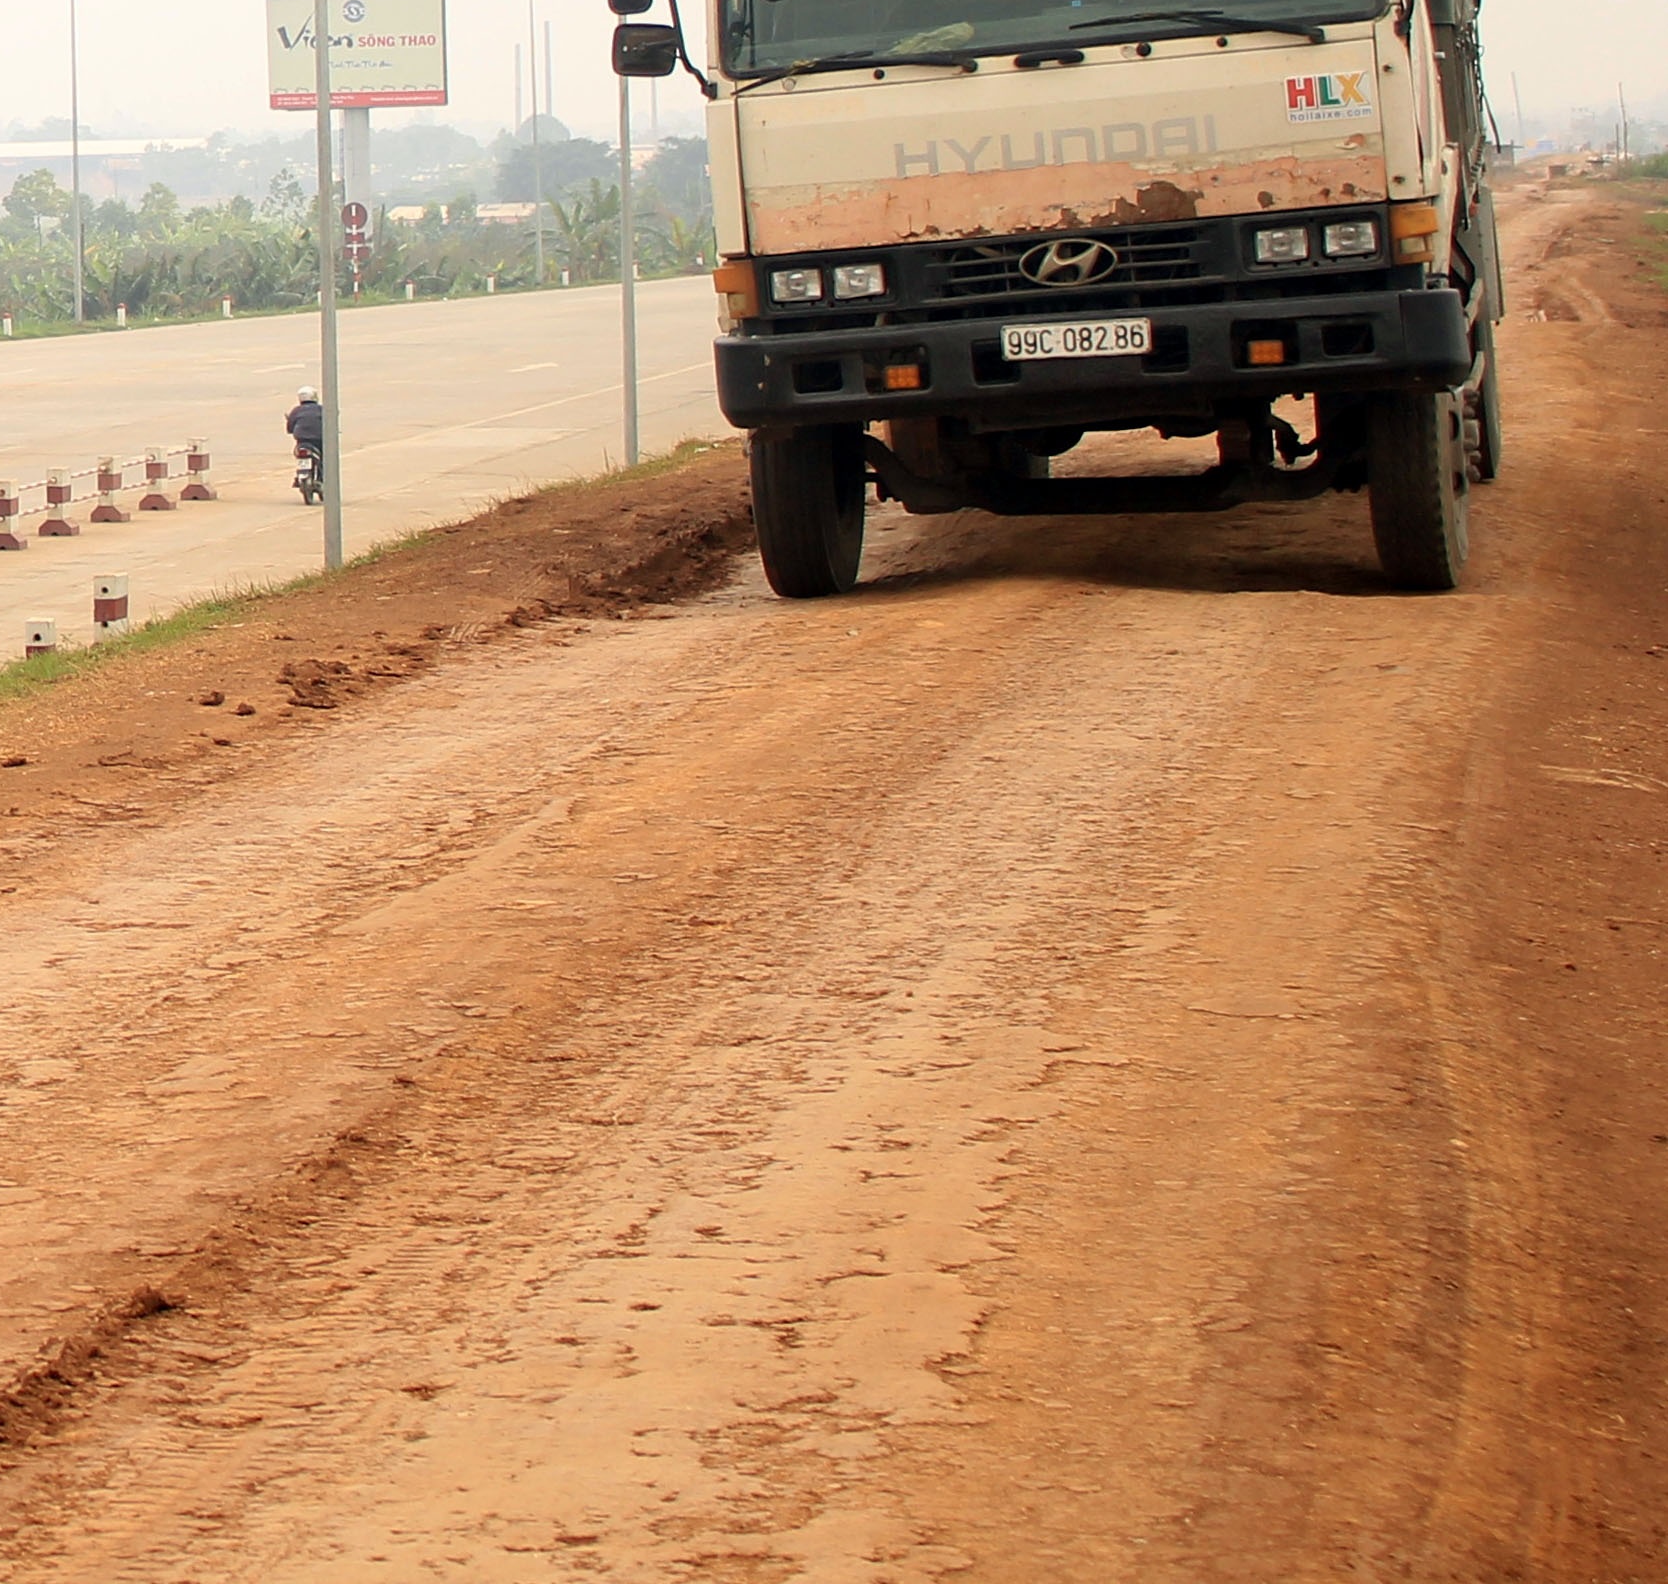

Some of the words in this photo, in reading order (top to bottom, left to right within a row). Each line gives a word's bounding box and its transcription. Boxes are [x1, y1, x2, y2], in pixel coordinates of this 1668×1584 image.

[399, 35, 436, 46] THAO
[1285, 72, 1366, 109] HLX
[893, 114, 1216, 179] HYUNDAI
